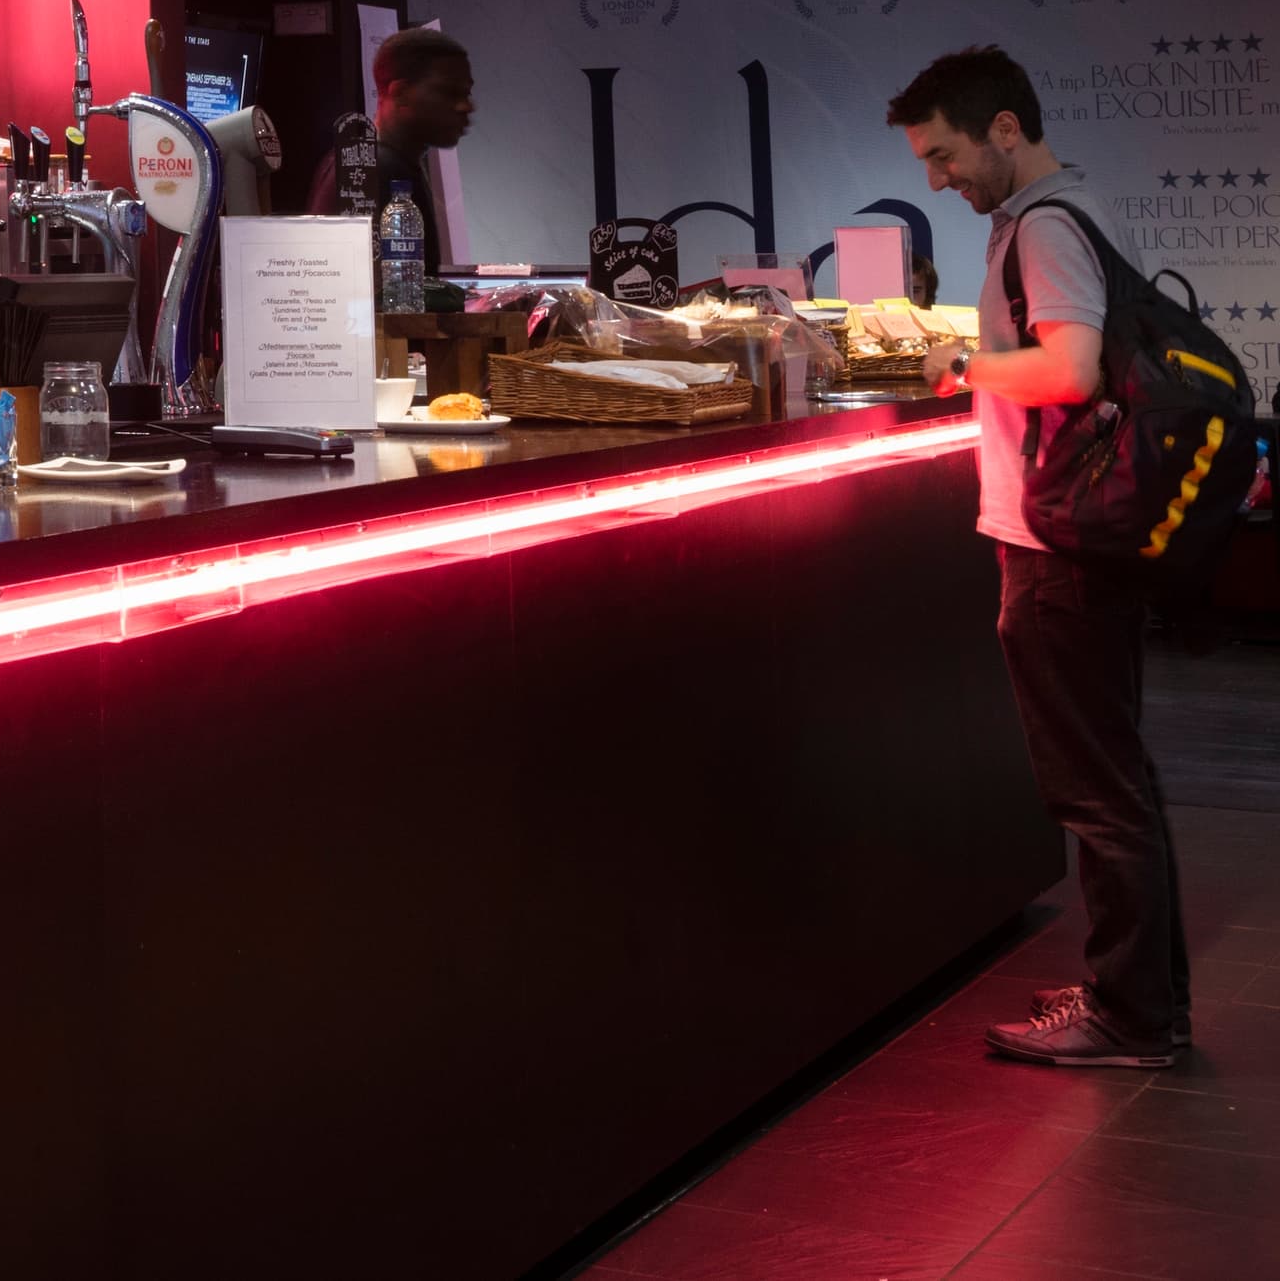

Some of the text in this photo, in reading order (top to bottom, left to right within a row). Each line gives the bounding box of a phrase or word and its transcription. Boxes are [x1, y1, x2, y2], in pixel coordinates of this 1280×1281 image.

[601, 0, 656, 12] LONDON
[188, 36, 196, 45] THE
[1060, 74, 1086, 93] trip
[1091, 62, 1162, 89] BACK
[1171, 61, 1198, 86] IN
[1206, 58, 1270, 84] TIME
[1072, 103, 1088, 120] in
[1096, 88, 1253, 120] EXQUISITE
[138, 157, 192, 171] PERONI
[390, 240, 416, 252] BELU
[629, 246, 638, 258] of
[641, 248, 660, 263] cake
[267, 258, 328, 268] Freshly Toasted
[1222, 256, 1236, 266] The
[256, 270, 285, 278] Paninis
[302, 270, 340, 278] Focaccias
[656, 282, 674, 300] DEAL
[304, 316, 327, 324] Cheese
[263, 361, 285, 369] Salami
[250, 370, 268, 378] Goats
[270, 370, 292, 378] Cheese
[328, 370, 352, 378] Chutney
